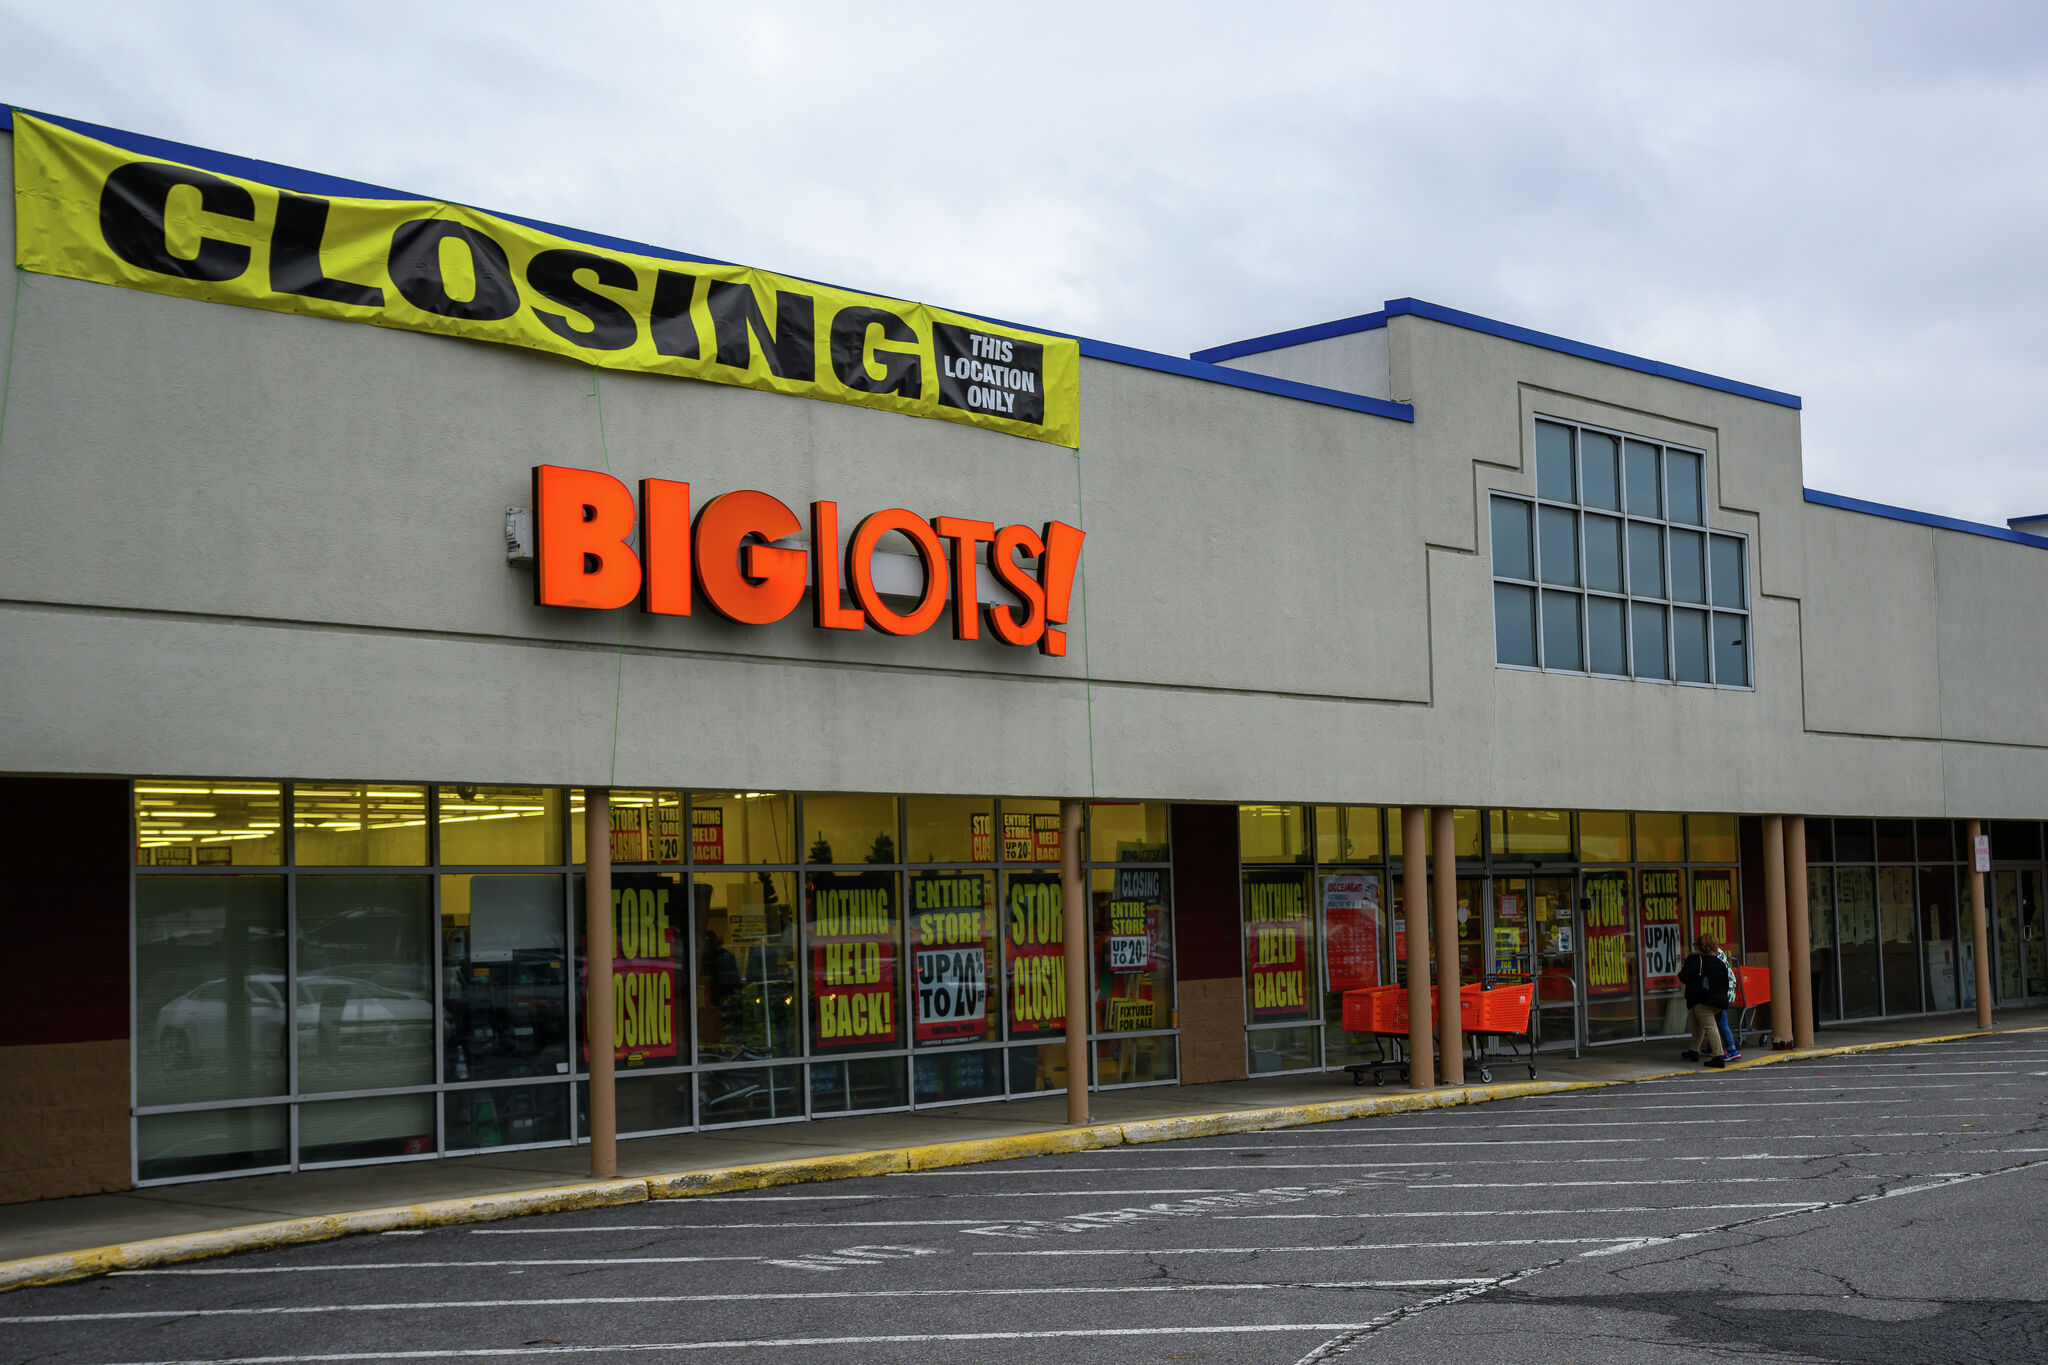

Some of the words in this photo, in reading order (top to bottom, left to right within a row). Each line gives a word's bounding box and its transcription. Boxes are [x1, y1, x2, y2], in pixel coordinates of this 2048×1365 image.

[99, 160, 922, 400] CLOSING
[969, 334, 1014, 363] THIS
[943, 355, 1035, 393] LOCATION
[967, 385, 1015, 413] ONLY
[532, 464, 808, 626] BIG
[609, 810, 639, 831] STORE
[692, 809, 721, 825] OTHING
[973, 815, 990, 835] STO
[1004, 814, 1031, 827] ENTIRE
[692, 828, 717, 843] HELD
[1005, 827, 1030, 839] STORE
[1038, 831, 1059, 845] HELD
[1006, 842, 1016, 850] UP
[1017, 841, 1031, 859] 20
[1007, 851, 1017, 859] TO
[915, 878, 982, 909] ENTIRE
[1122, 871, 1160, 898] CLOSING
[1327, 883, 1363, 892] DECEMBER
[1642, 872, 1678, 895] ENTIRE
[1695, 879, 1731, 912] NOTHING
[816, 888, 889, 936] NOTHING
[1012, 882, 1063, 946] STOR
[1110, 901, 1145, 918] ENTIRE
[1250, 882, 1302, 923] NOTHING
[1586, 879, 1625, 928] STORE
[1645, 897, 1679, 921] STORE
[611, 888, 671, 960] TORE
[920, 912, 982, 946] STORE
[1111, 918, 1145, 935] STORE
[1644, 927, 1662, 949] UP
[1700, 915, 1727, 945] HELD
[1112, 940, 1127, 952] UP
[1112, 953, 1127, 965] TO
[1258, 927, 1297, 965] HELD
[826, 942, 881, 986] HELD
[917, 954, 951, 984] UP
[1588, 935, 1628, 987] CLOSING
[1646, 951, 1664, 974] TO
[920, 987, 951, 1018] TO
[1014, 955, 1066, 1022] CLOSIN
[1253, 970, 1304, 1009] BACK!
[587, 971, 672, 1048] OSING
[819, 992, 891, 1038] BACK!
[1120, 1003, 1153, 1019] FIXTURES
[1119, 1019, 1134, 1032] FOR
[1135, 1017, 1153, 1031] SALE
